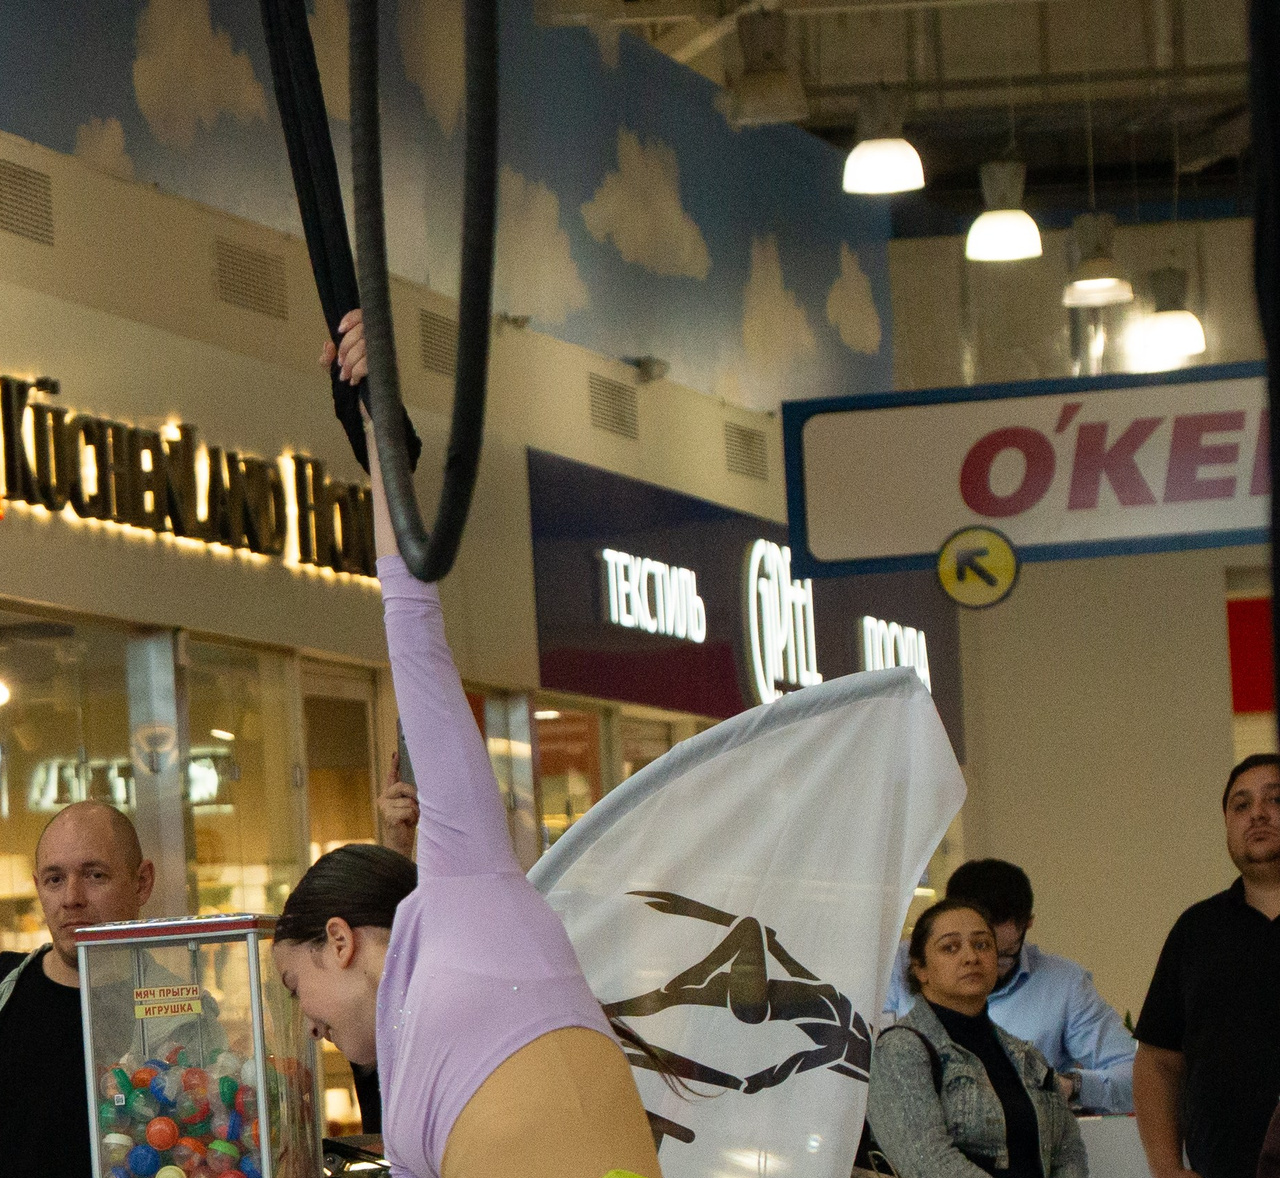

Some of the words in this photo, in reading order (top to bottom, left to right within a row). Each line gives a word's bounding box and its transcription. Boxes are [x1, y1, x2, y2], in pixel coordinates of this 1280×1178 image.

[293, 453, 377, 578] HOM
[602, 548, 707, 644] ТЕКСТИЛЬ
[135, 989, 156, 999] МЯЧ
[158, 986, 198, 998] ПРЫГУН
[144, 1003, 194, 1016] ИГРУШКА
